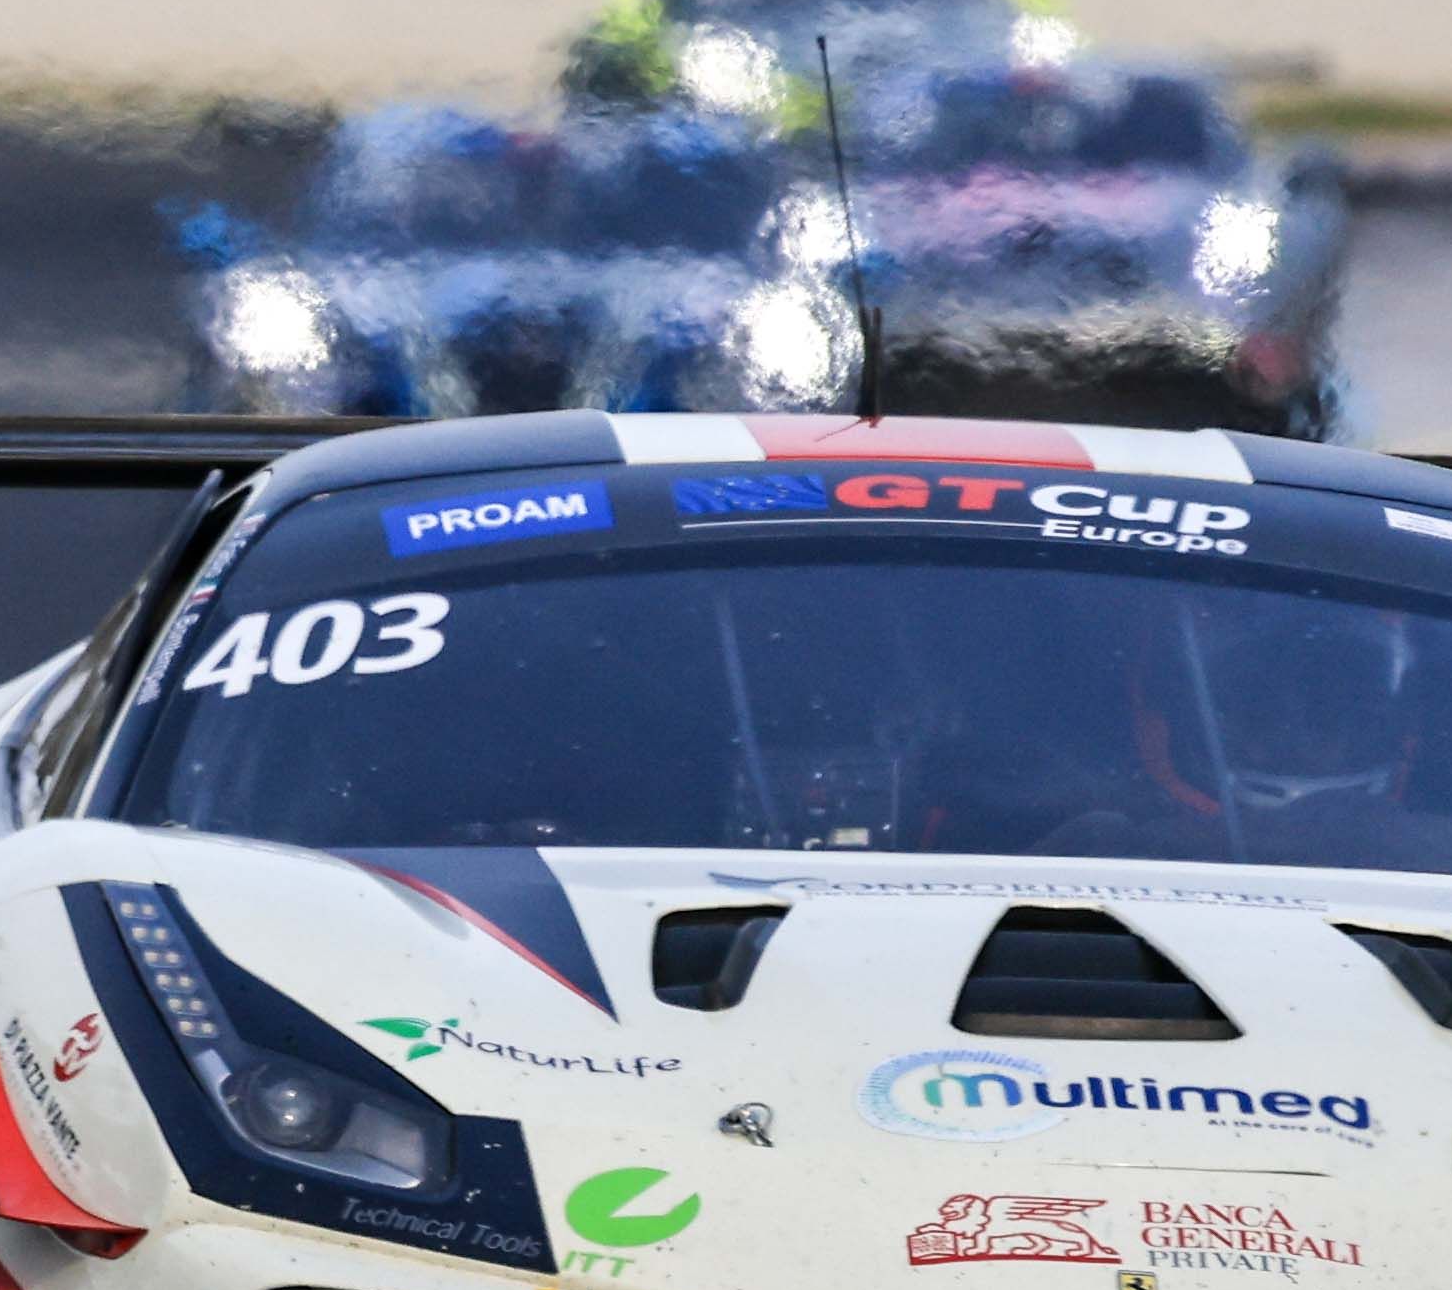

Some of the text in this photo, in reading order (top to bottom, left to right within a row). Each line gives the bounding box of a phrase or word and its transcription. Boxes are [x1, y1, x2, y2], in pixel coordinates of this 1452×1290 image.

[406, 493, 588, 540] PROAM
[834, 474, 1251, 536] GT Cup
[1040, 518, 1250, 556] Europe
[183, 591, 450, 699] 403
[438, 1026, 684, 1078] NaturLife
[341, 1196, 544, 1259] Technical Tools
[1139, 1200, 1297, 1231] BANCA
[560, 1250, 636, 1278] ITT
[1141, 1226, 1366, 1267] GENERALI
[1148, 1249, 1301, 1276] PRIVATE
